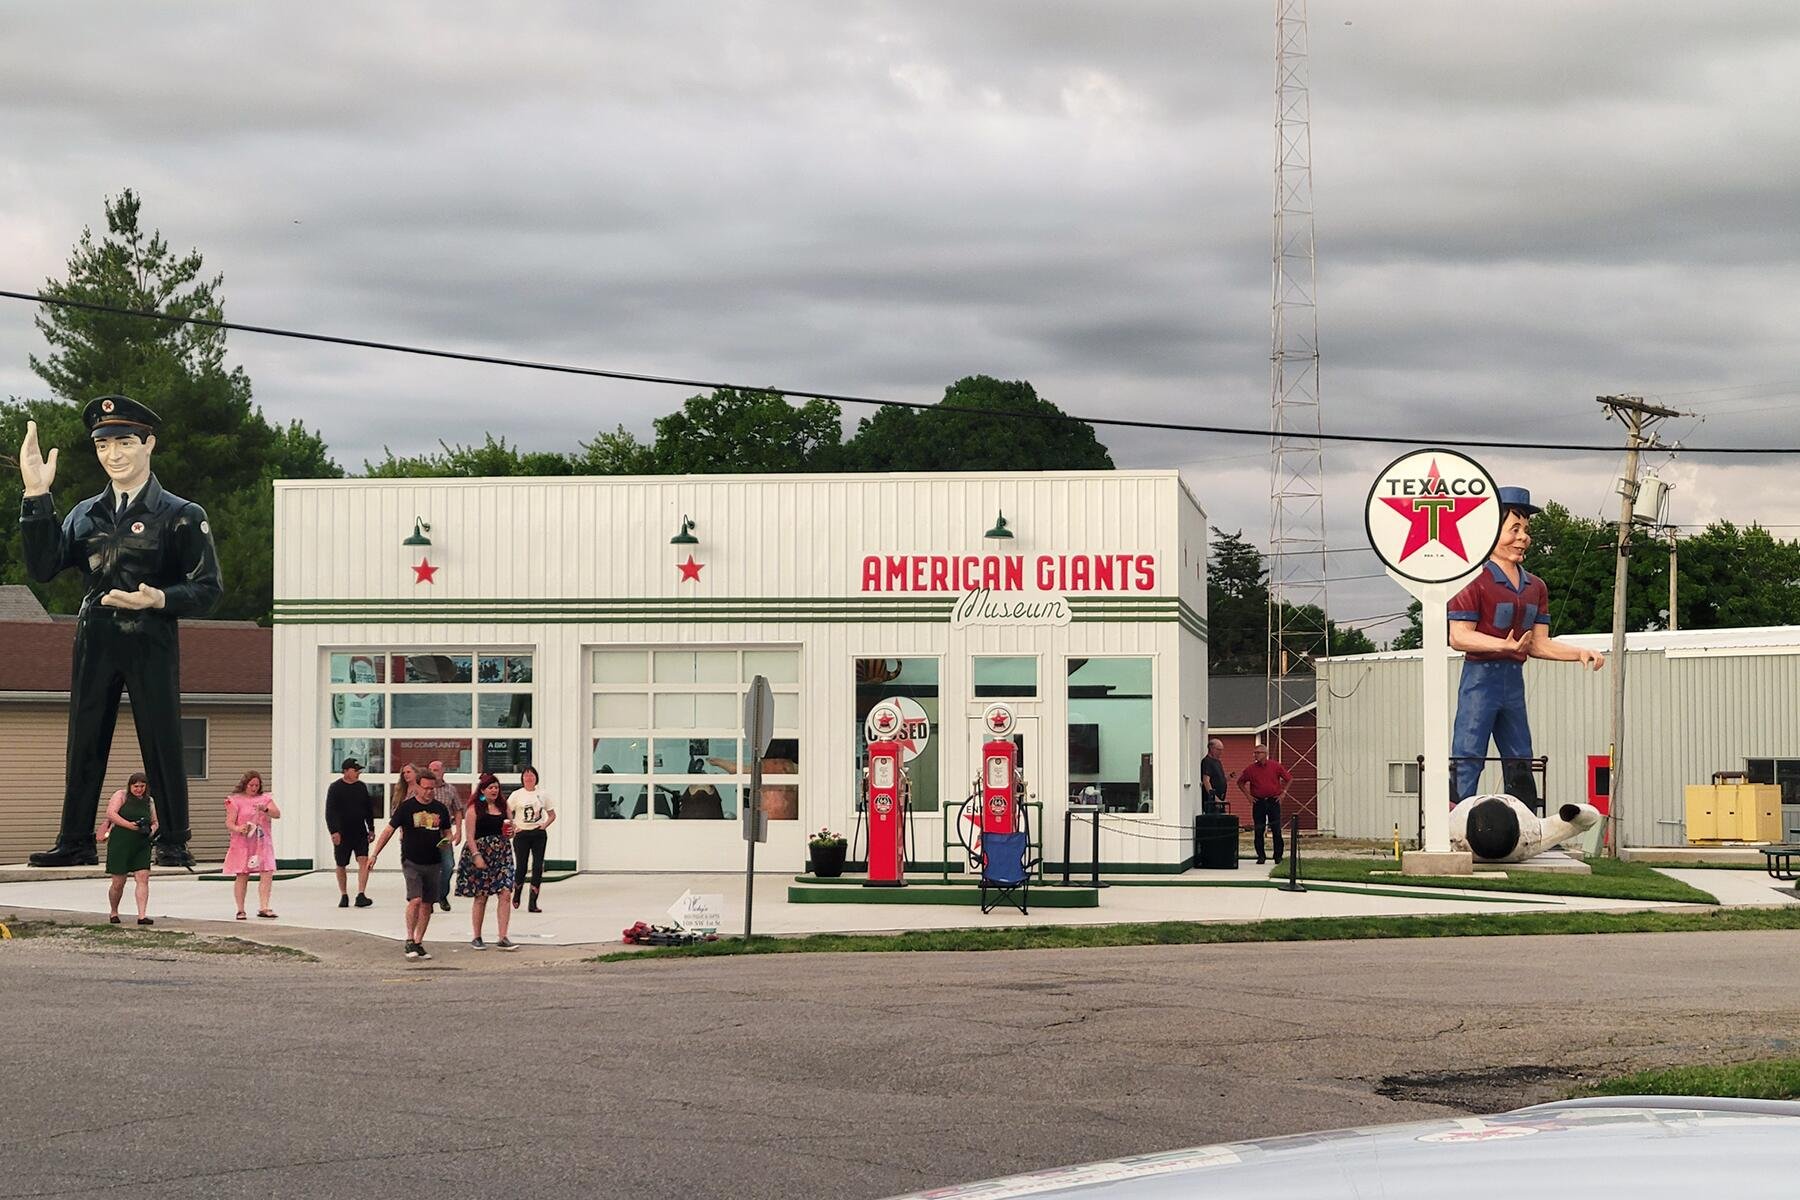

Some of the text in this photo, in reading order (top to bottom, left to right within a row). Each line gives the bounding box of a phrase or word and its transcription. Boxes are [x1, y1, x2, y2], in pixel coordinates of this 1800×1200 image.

[1386, 478, 1486, 496] TEXACO
[1413, 499, 1455, 541] T
[861, 554, 1155, 592] AMERICAN GIANTS
[956, 586, 1065, 623] Museum
[867, 722, 928, 742] CSED
